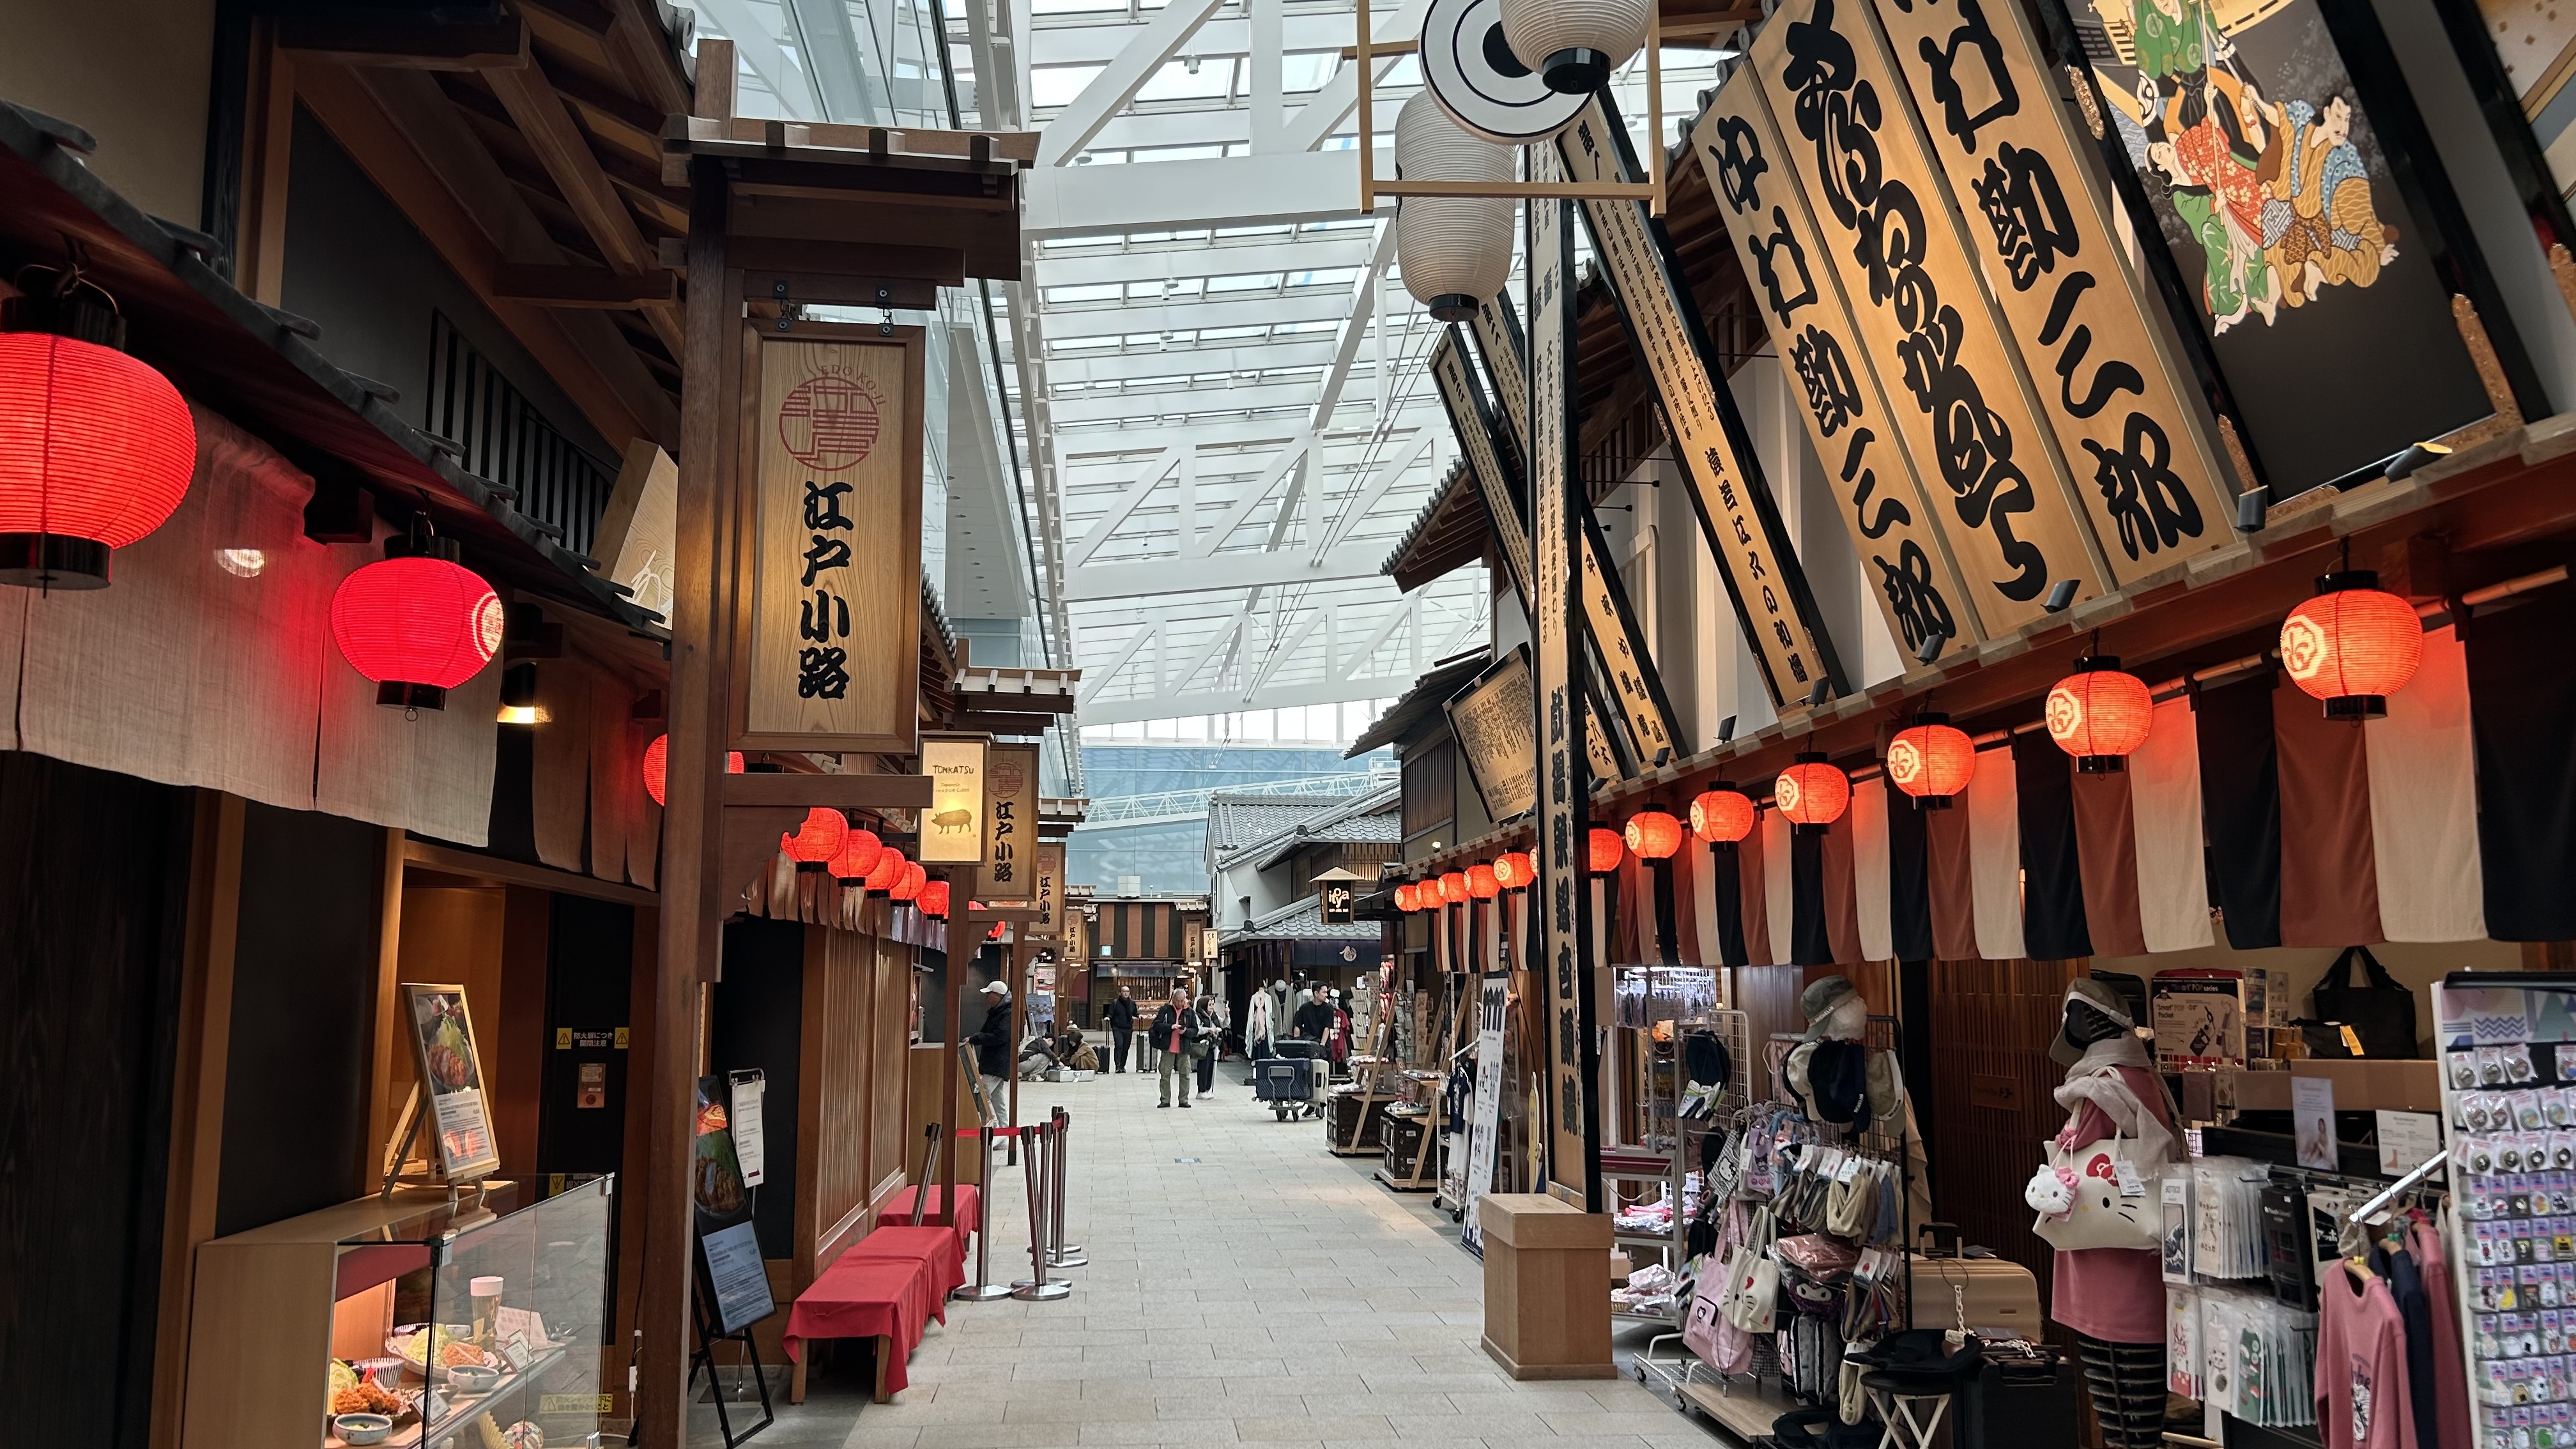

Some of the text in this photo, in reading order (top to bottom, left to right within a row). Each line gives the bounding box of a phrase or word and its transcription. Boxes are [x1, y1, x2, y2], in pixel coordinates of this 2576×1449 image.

[1899, 0, 2204, 561] 村勘三郎
[821, 364, 852, 376] EDO
[798, 480, 854, 700] 江戸小路
[932, 765, 974, 774] TONKATSU
[994, 801, 1015, 882] 江戸小路
[1328, 887, 1350, 908] itoya
